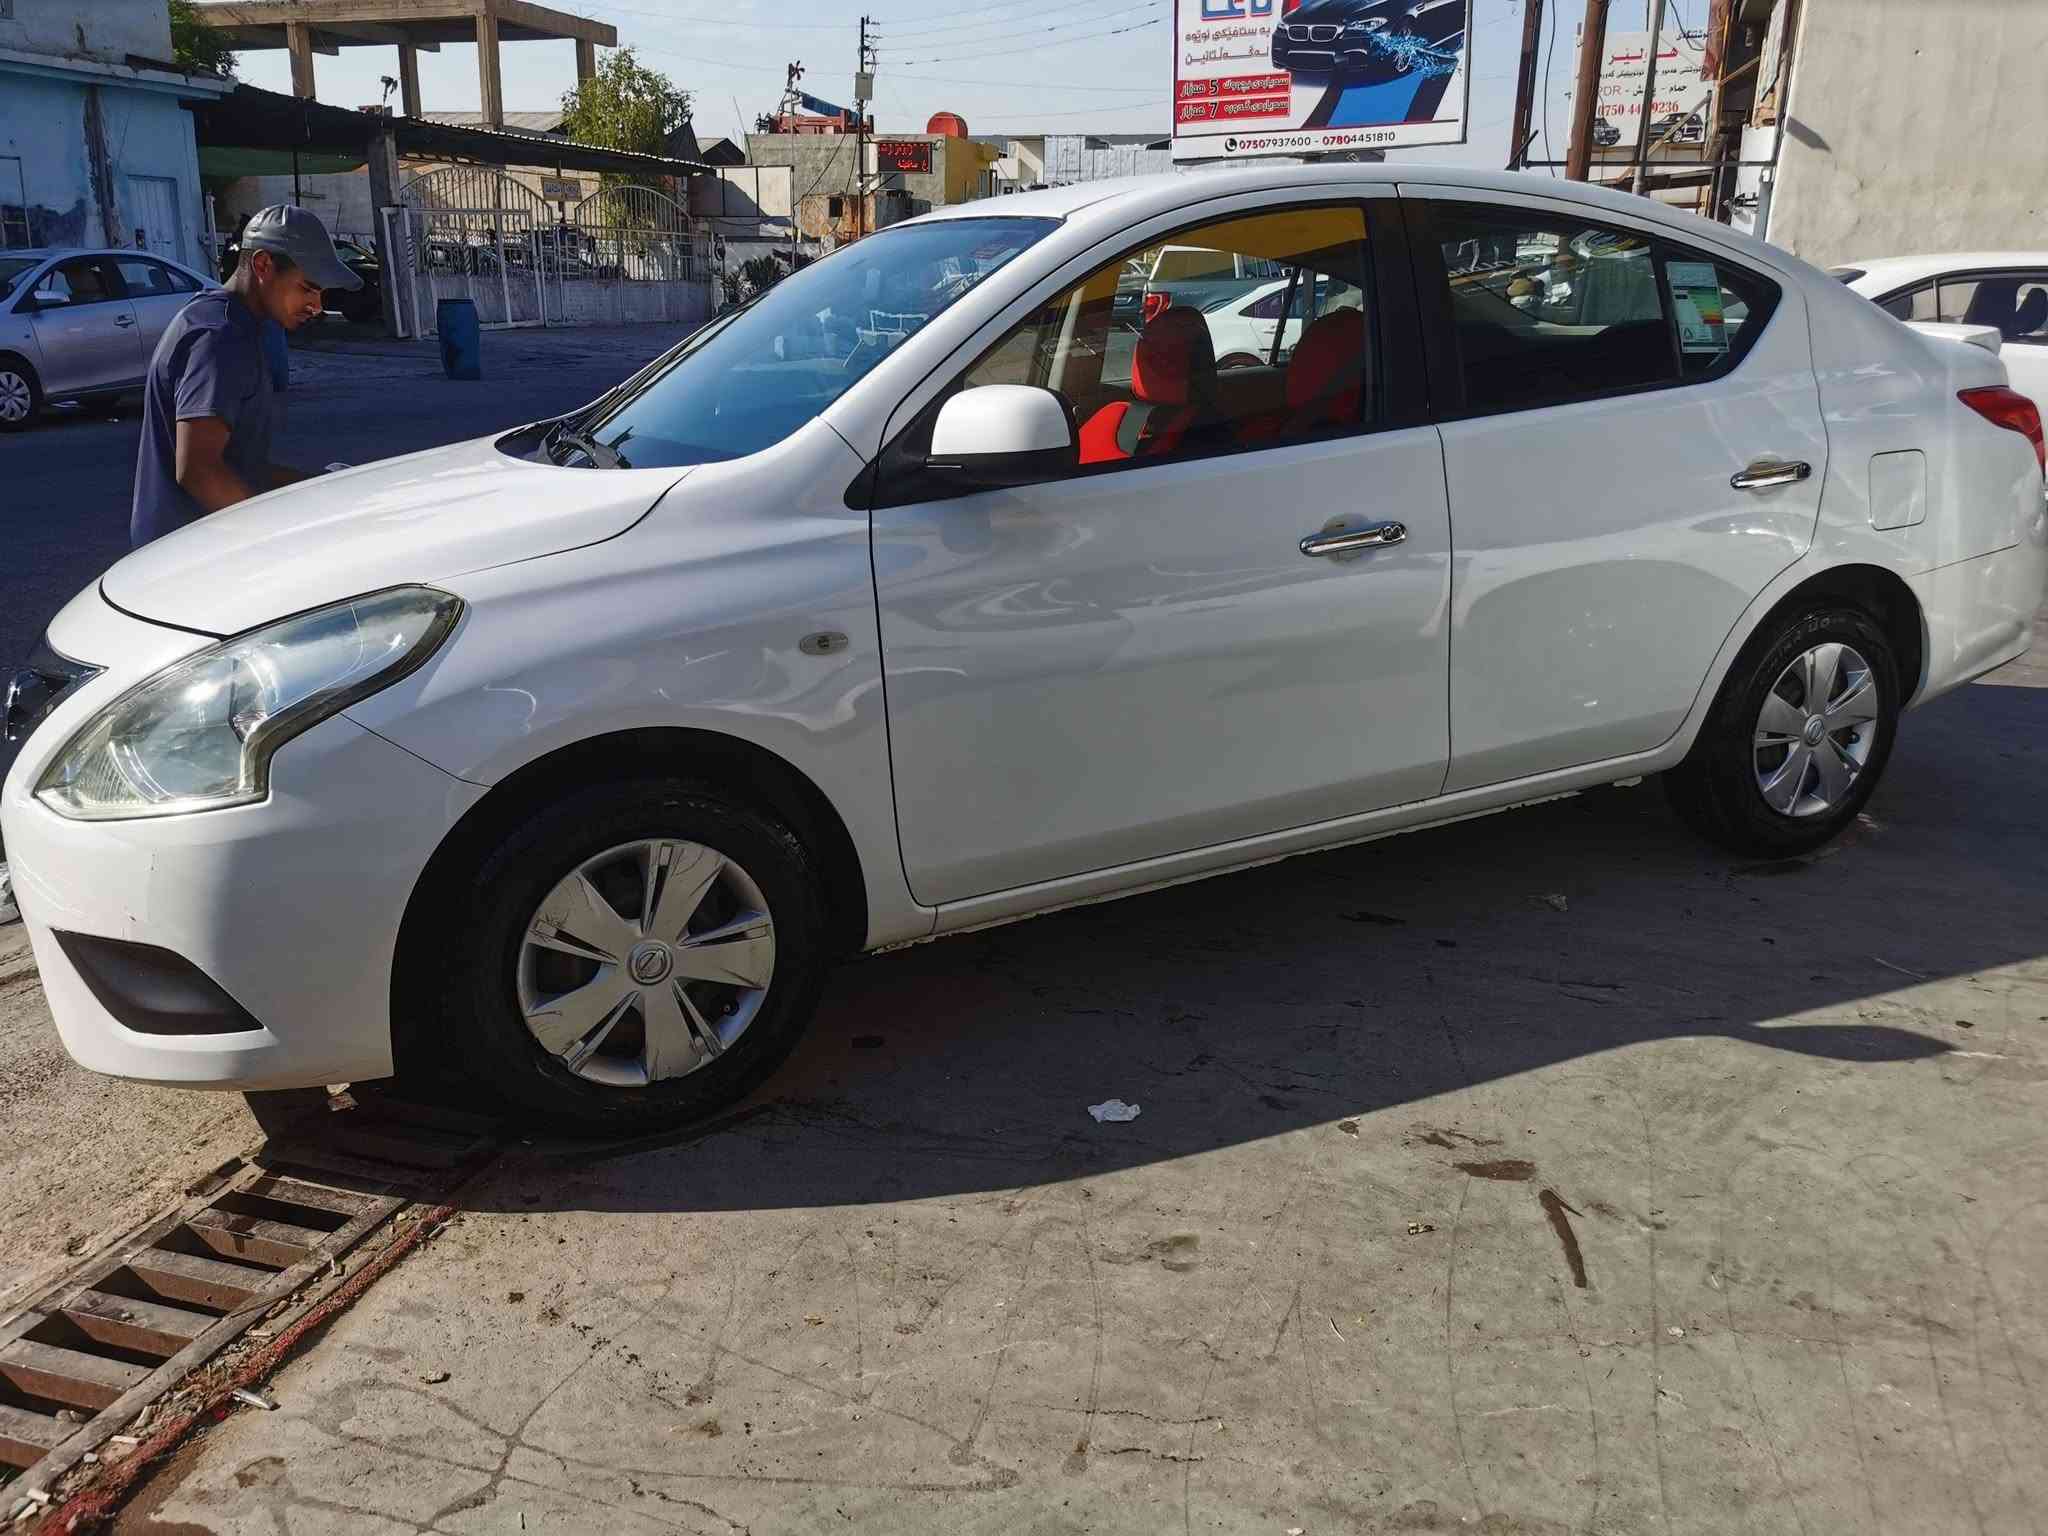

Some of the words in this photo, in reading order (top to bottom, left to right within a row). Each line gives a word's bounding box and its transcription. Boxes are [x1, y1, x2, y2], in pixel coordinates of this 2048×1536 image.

[1209, 79, 1219, 96] 5
[1209, 101, 1218, 118] 7
[1239, 137, 1311, 149] 07507937600
[1322, 131, 1396, 145] 07804451810
